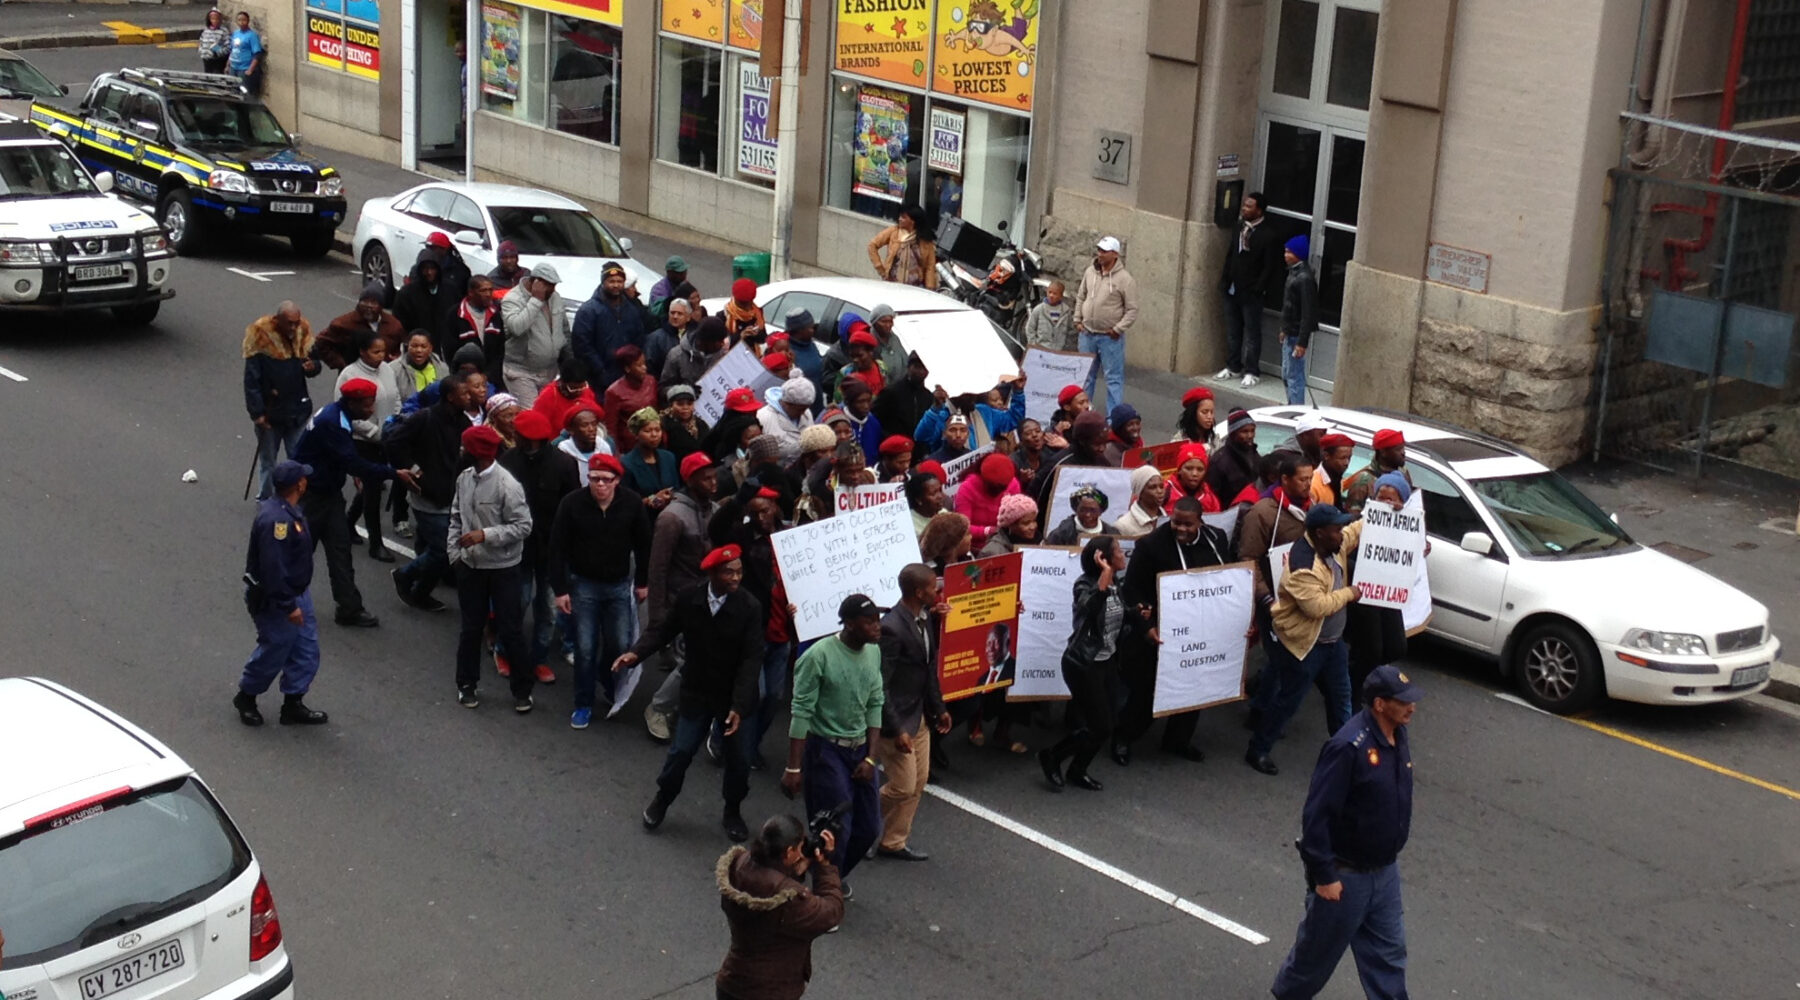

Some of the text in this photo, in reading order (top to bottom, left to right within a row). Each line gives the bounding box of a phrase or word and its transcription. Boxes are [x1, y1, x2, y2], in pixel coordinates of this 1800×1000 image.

[310, 18, 380, 48] GOING UNDER
[840, 41, 924, 55] INTERNATIONAL
[841, 57, 881, 68] BRANDS
[953, 61, 1012, 77] LOWEST
[954, 79, 1006, 94] PRICES
[744, 120, 778, 144] SAL
[1098, 137, 1125, 165] 37
[117, 171, 158, 199] POLICE
[849, 511, 877, 528] OLD
[1366, 508, 1420, 533] SOUTH AFRICA
[783, 547, 816, 568] DIED
[824, 549, 859, 568] BEING
[1363, 543, 1414, 567] IS FOUND ON
[1031, 566, 1067, 576] MANDELA
[1172, 585, 1233, 601] LET'S REVISIT
[1357, 581, 1409, 604] STOLEN LAND
[1032, 611, 1056, 621] HATED
[1172, 627, 1190, 637] THE
[1181, 641, 1206, 653] LAND
[1180, 653, 1226, 669] QUESTION
[1022, 669, 1056, 679] EVICTIONS
[84, 944, 182, 998] CY 287-720
